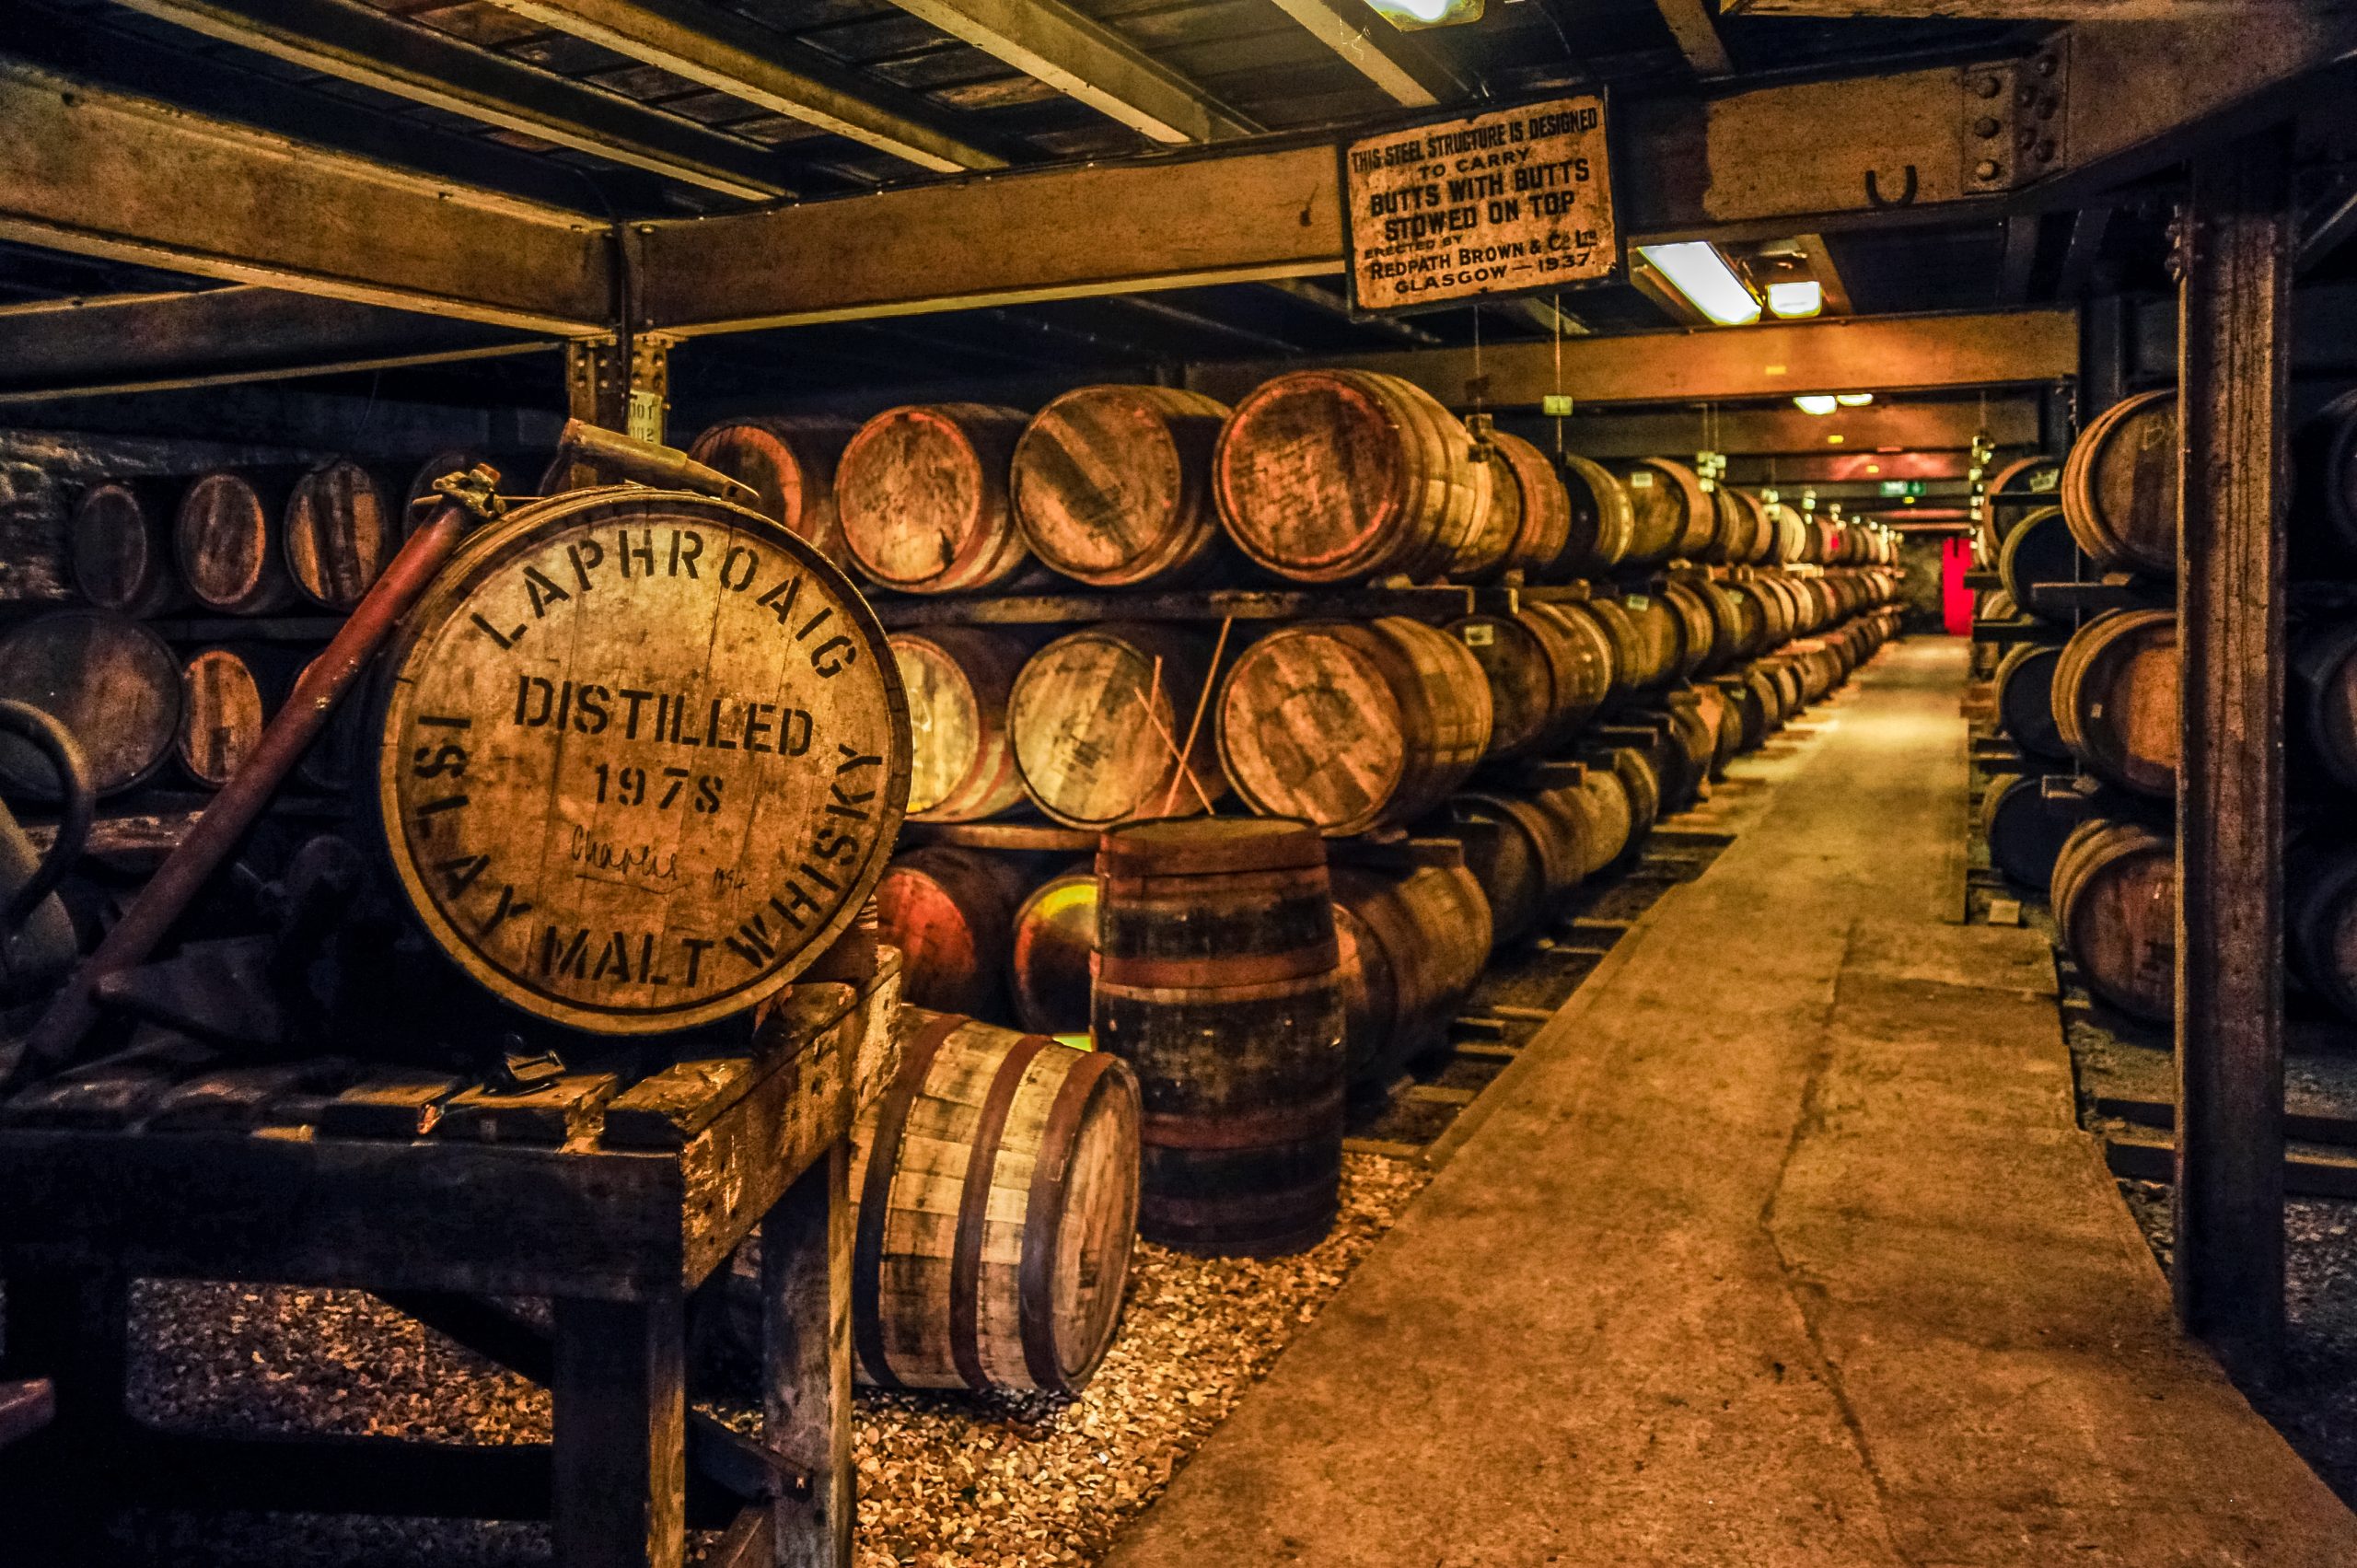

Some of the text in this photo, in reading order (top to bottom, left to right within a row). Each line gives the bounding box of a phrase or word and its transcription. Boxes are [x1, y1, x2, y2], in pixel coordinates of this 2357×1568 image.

[1351, 107, 1598, 173] THIS STEEL STRUCTURE IS DESIGNED
[1418, 147, 1530, 180] TO CARRY
[1370, 157, 1589, 217] BUTTS WITH BUTTS
[1385, 190, 1575, 243] STOWED ON TOP
[1364, 234, 1463, 260] ERECTED BY
[1395, 264, 1507, 295] GLASGOW
[470, 529, 858, 679] LAPHROAIG
[513, 675, 814, 758] DISTILLED
[413, 715, 884, 989] ISLAY MALT WHISKY
